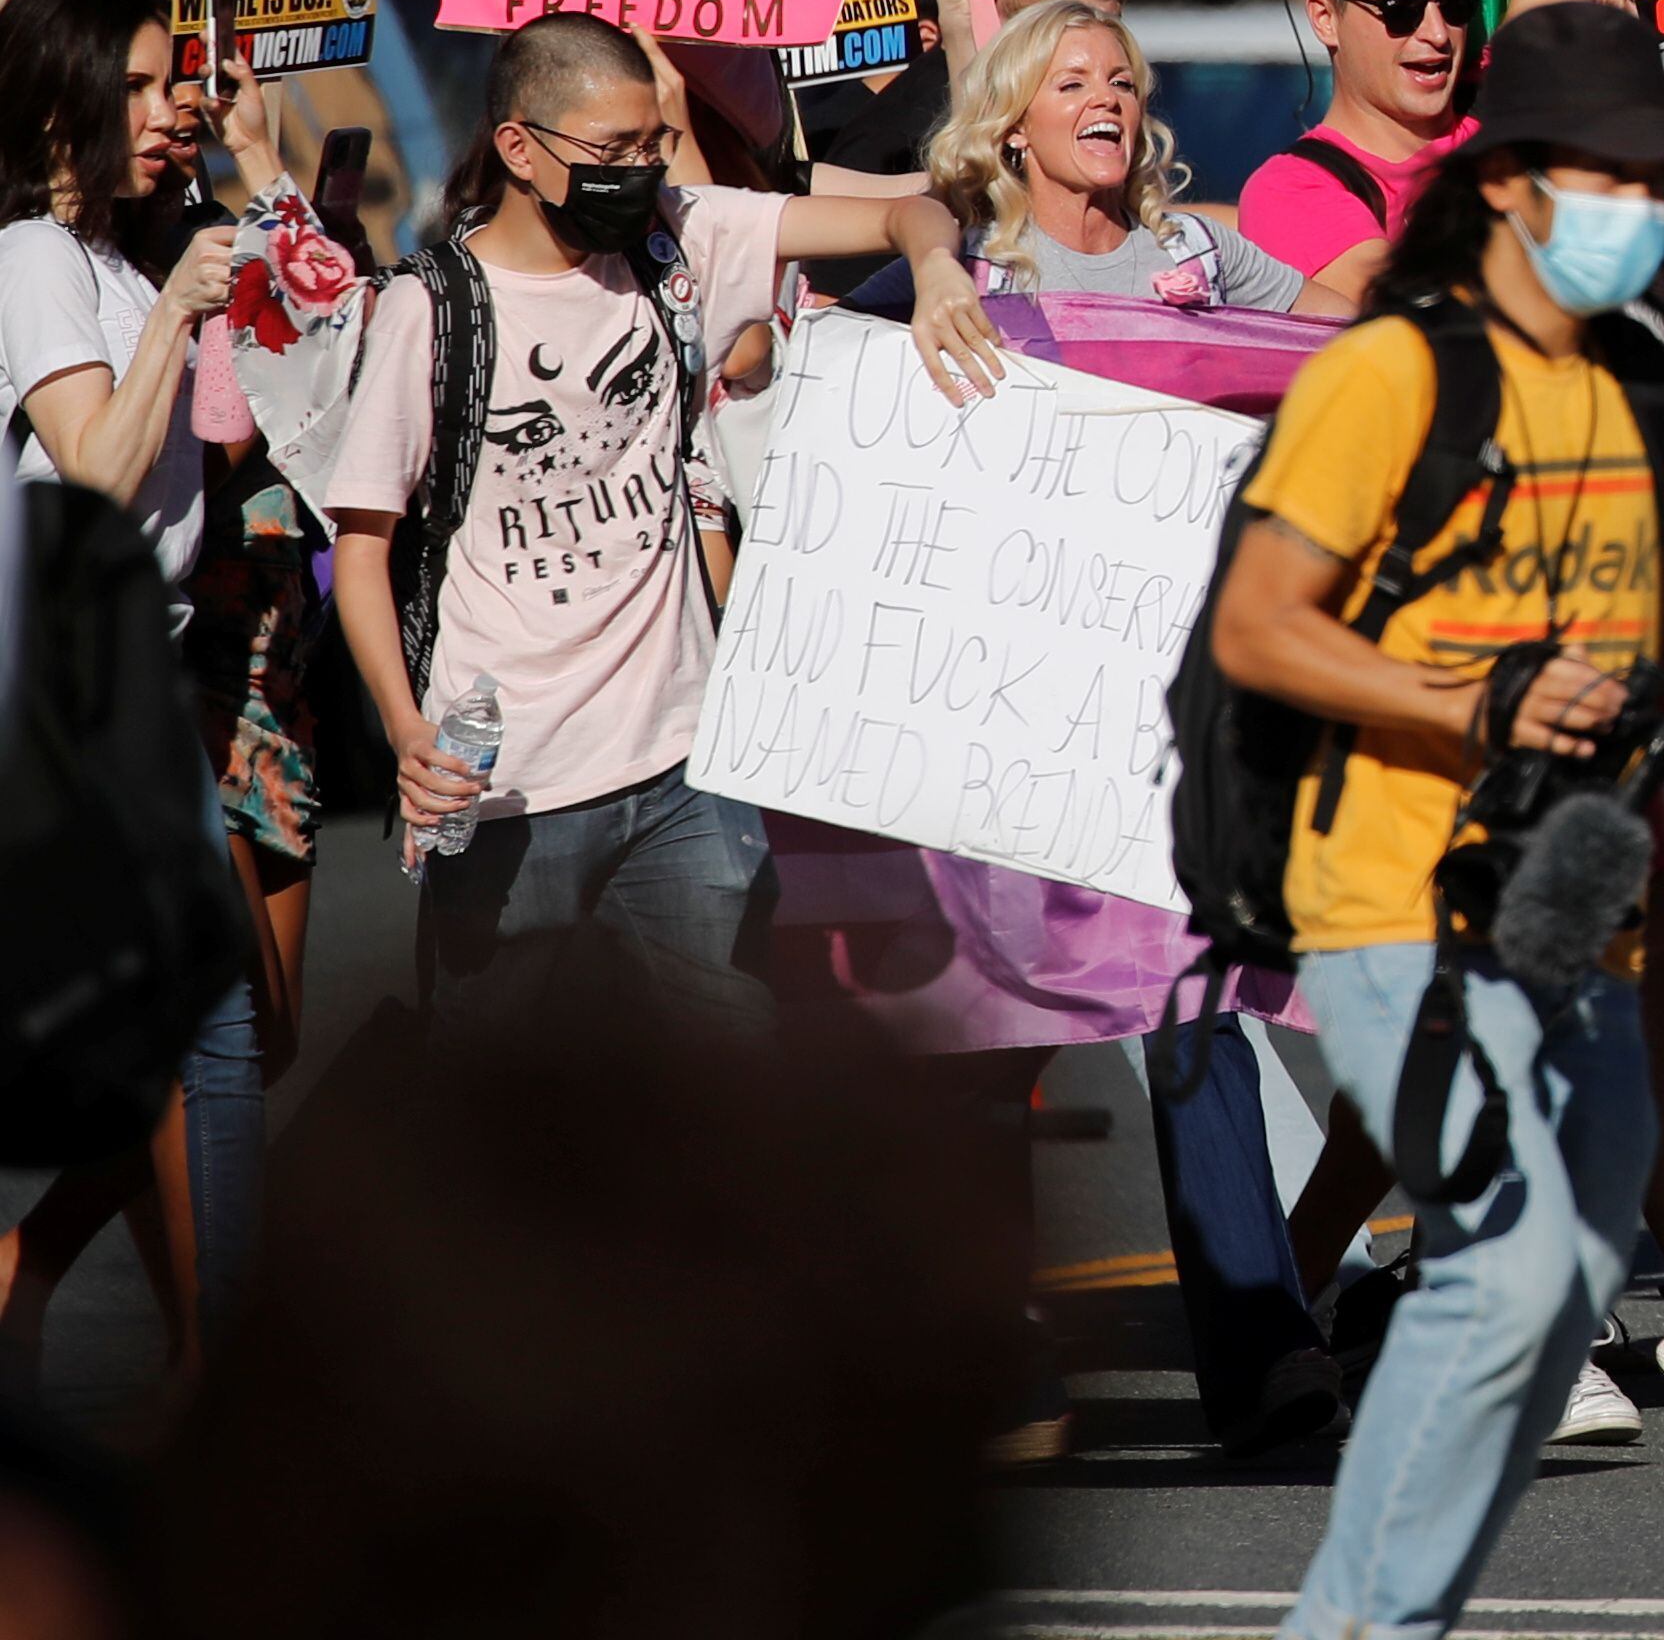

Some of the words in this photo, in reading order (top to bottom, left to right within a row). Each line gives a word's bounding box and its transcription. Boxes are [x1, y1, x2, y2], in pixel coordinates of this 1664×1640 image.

[499, 445, 678, 550] RITUAL
[1009, 382, 1090, 501] THE
[505, 549, 603, 584] FEST
[749, 448, 845, 555] END
[871, 481, 977, 592] THE
[723, 562, 844, 683] AND
[856, 601, 1049, 728] FUCK
[1048, 664, 1106, 761] A
[700, 673, 928, 828] NAMED
